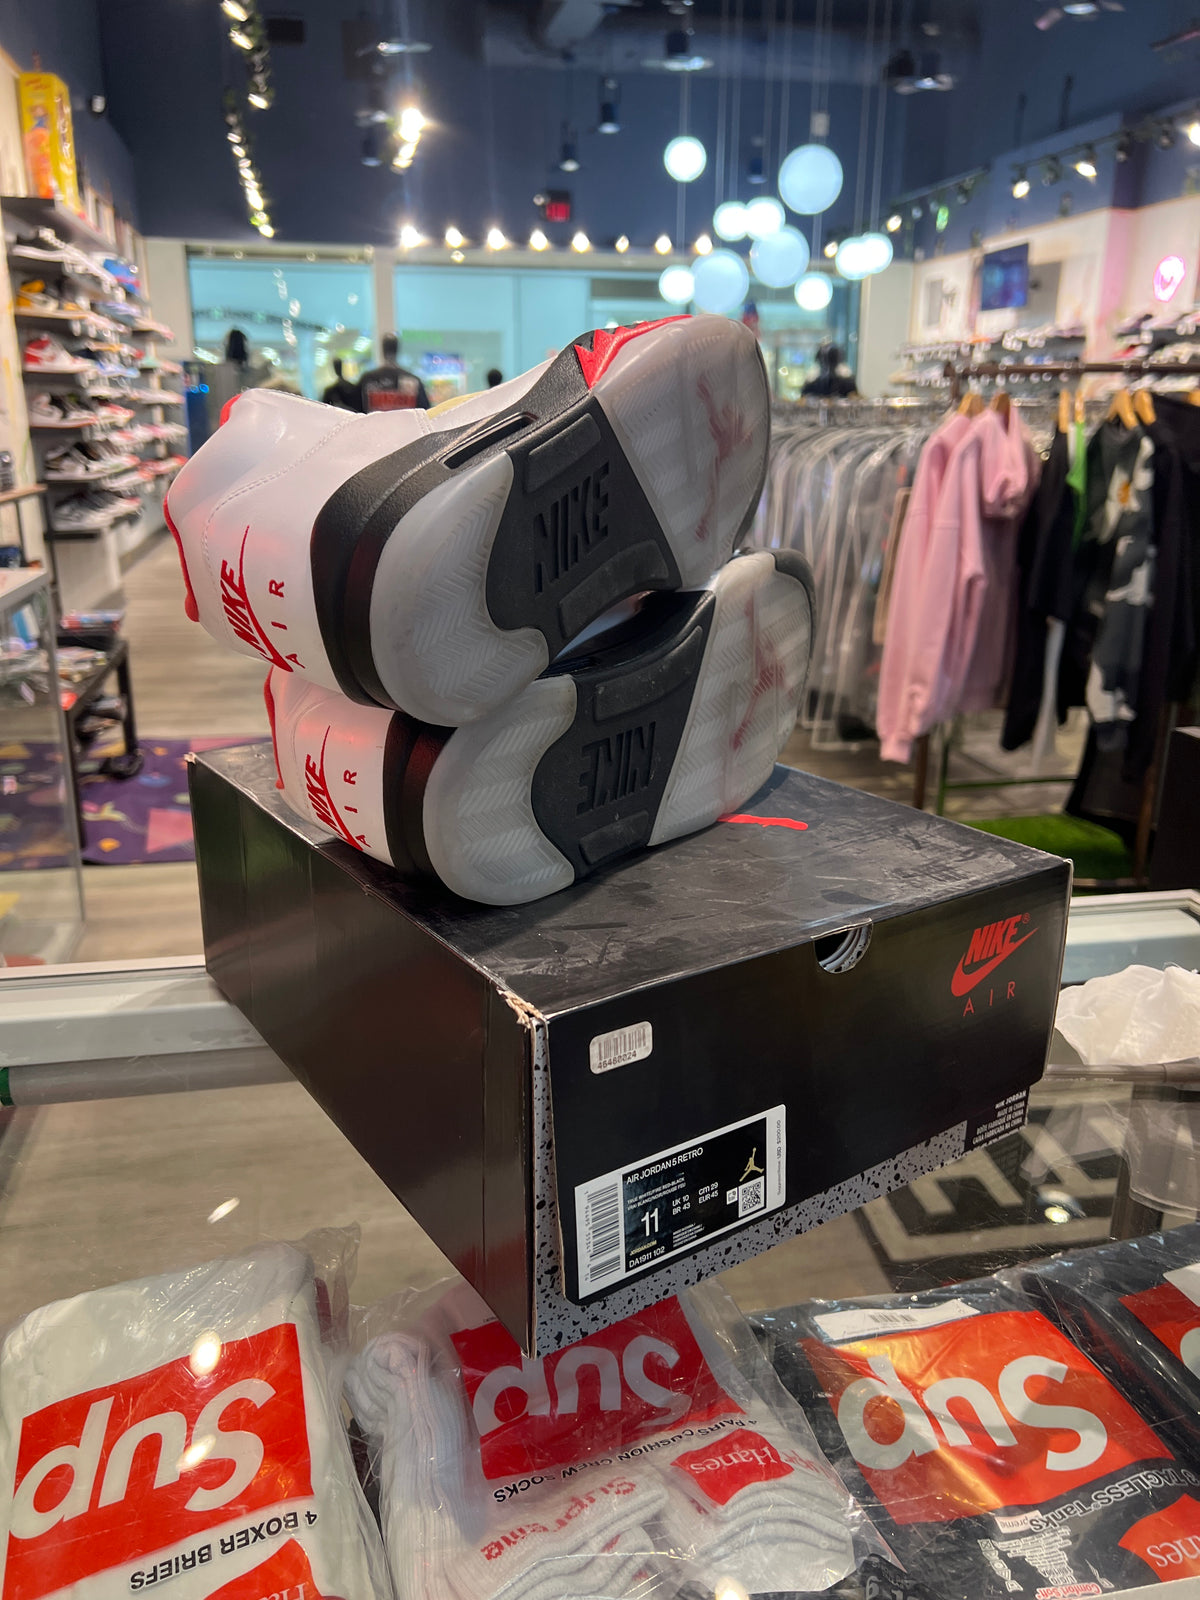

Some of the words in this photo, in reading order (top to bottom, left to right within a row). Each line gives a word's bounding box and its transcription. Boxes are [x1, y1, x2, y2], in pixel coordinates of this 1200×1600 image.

[533, 460, 610, 595] NIKE
[220, 559, 268, 657] NIKE
[269, 578, 305, 669] AIR
[575, 720, 657, 816] NIKE
[305, 754, 346, 838] NIKE
[344, 769, 372, 848] AIR
[963, 981, 1016, 1017] AIR
[626, 1173, 640, 1185] AIR
[639, 1160, 672, 1180] JORDAN
[672, 1157, 678, 1167] 5
[677, 1147, 704, 1165] RETRO
[672, 1199, 681, 1207] UK
[682, 1194, 690, 1202] 10
[698, 1185, 711, 1196] cm
[710, 1181, 719, 1191] 29
[698, 1192, 711, 1204] EUR
[710, 1190, 719, 1199] 45
[641, 1207, 659, 1237] 11
[672, 1205, 682, 1216] BR
[682, 1202, 691, 1211] 43
[628, 1252, 653, 1269] DA1911
[653, 1245, 666, 1257] 102
[473, 1335, 692, 1437] Sup
[697, 1418, 746, 1437] PAIRS
[838, 1353, 1108, 1471] Sup
[9, 1377, 277, 1540] Sup
[617, 1428, 695, 1462] CUSHION
[690, 1446, 778, 1474] Hanes
[220, 1511, 299, 1556] BOXER
[304, 1510, 318, 1526] 4
[1029, 1501, 1092, 1532] Tanks
[130, 1544, 213, 1590] BRIEFS
[1146, 1534, 1200, 1568] nes
[1061, 1583, 1101, 1595] Comfort
